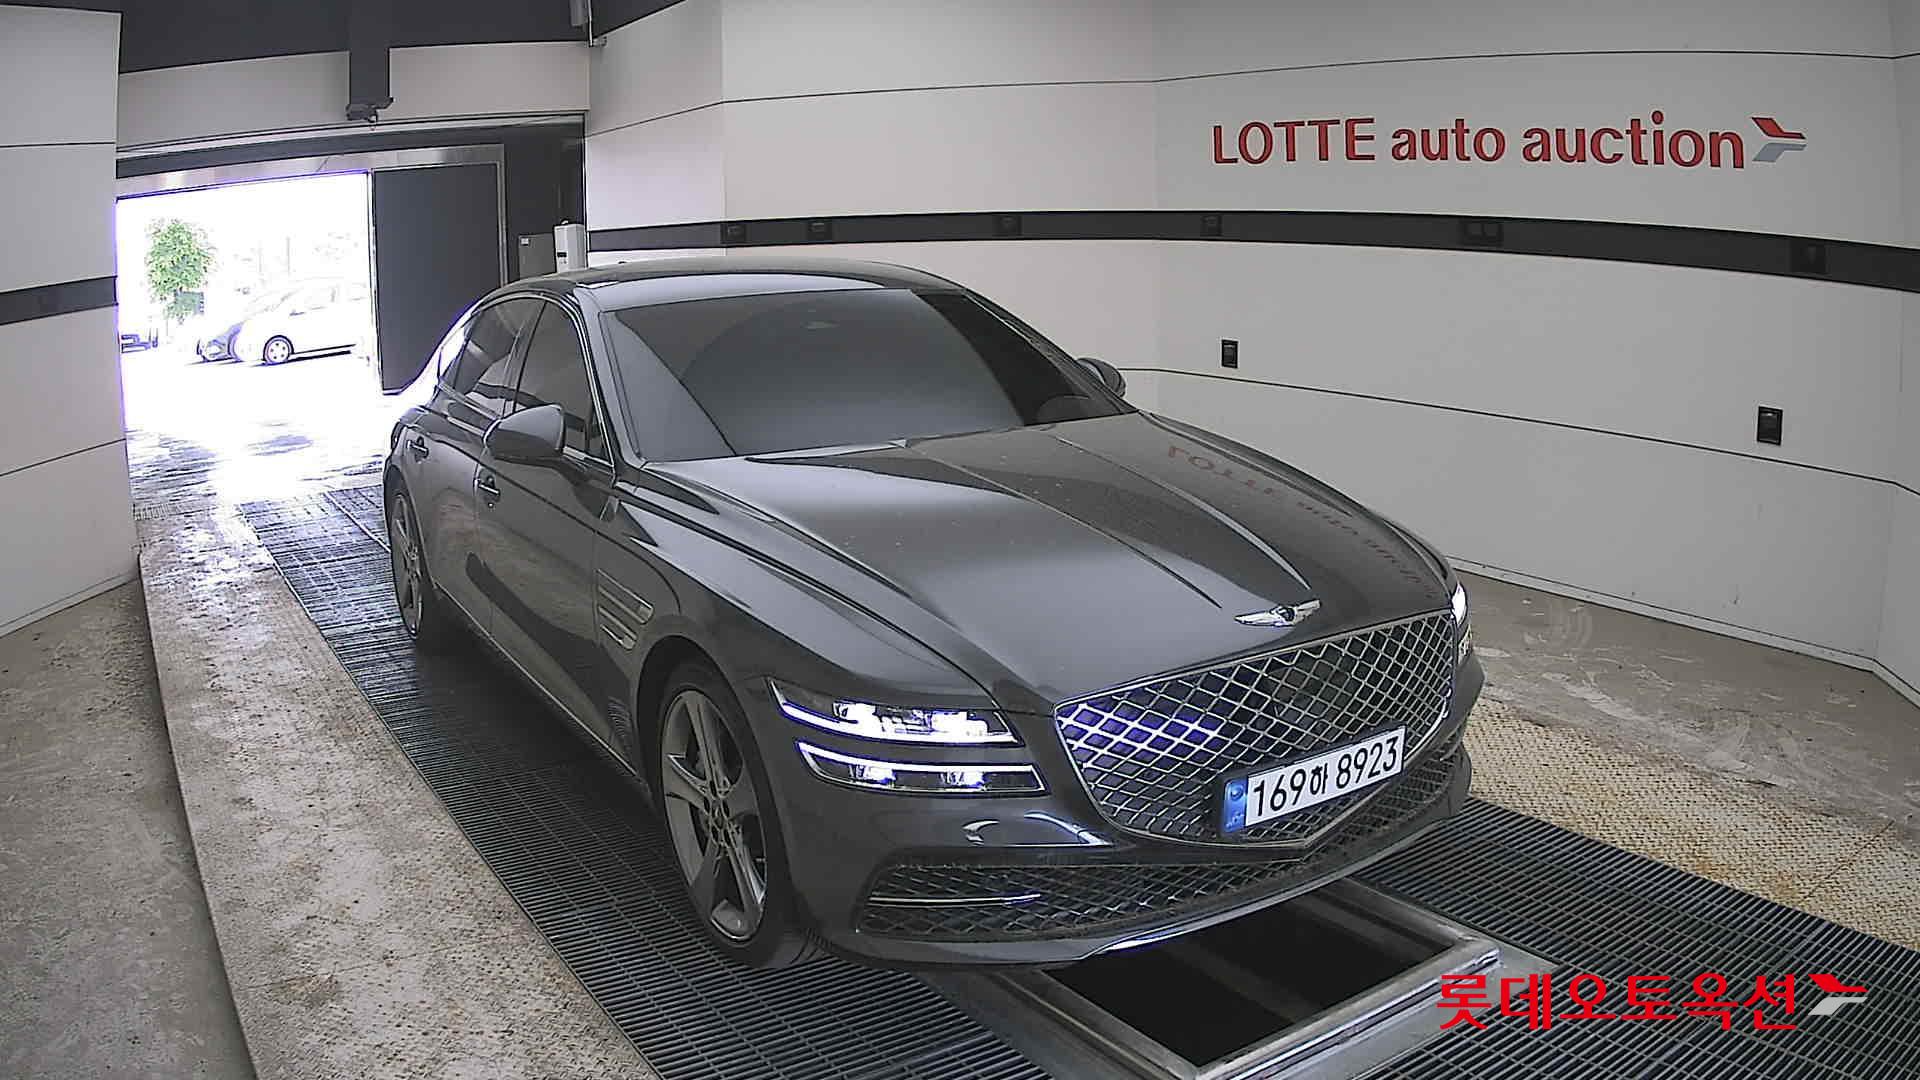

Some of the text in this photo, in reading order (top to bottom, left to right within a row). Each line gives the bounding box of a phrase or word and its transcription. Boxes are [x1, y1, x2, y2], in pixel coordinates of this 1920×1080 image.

[1213, 110, 1745, 169] LOTTE auto auction
[1253, 736, 1400, 817] 169하 8923
